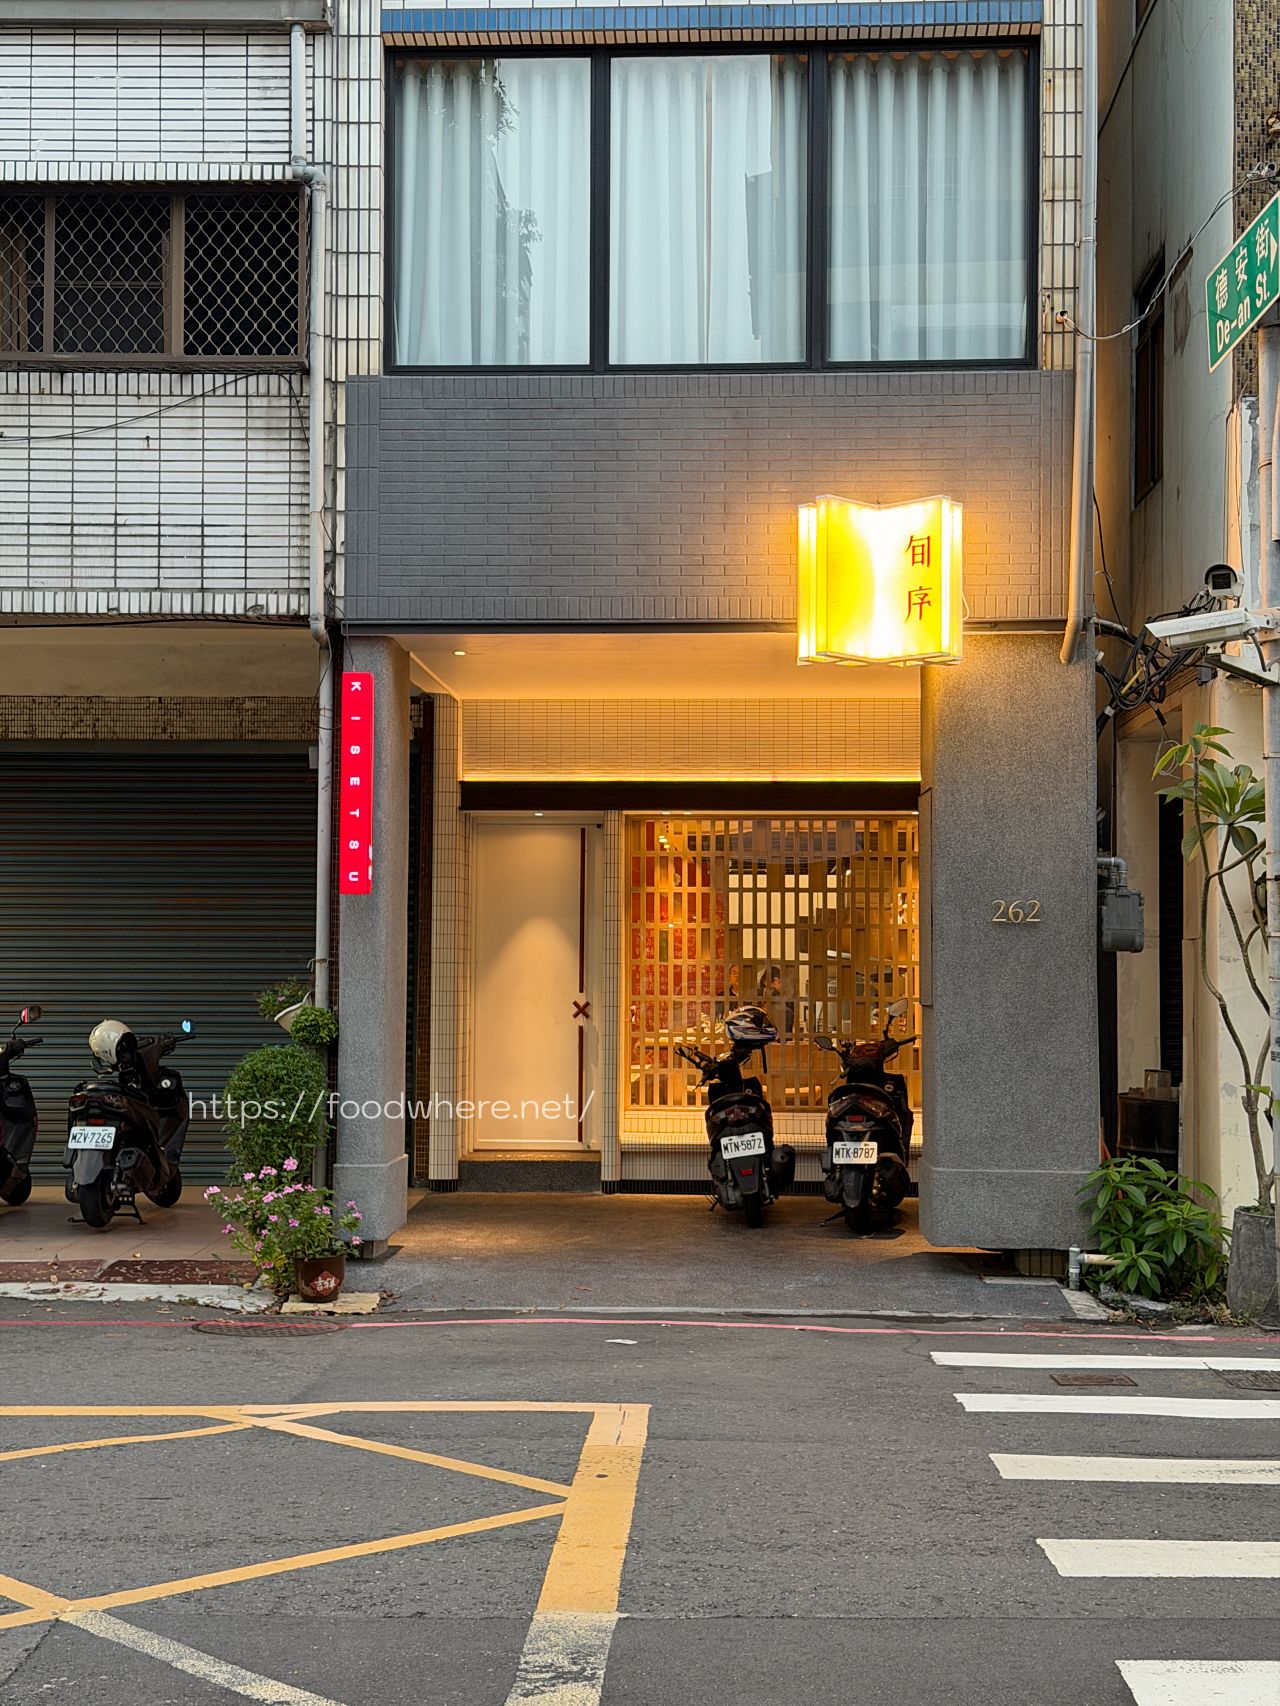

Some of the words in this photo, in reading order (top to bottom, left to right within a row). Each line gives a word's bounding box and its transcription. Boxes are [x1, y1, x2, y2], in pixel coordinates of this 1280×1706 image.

[1215, 218, 1269, 313] 德安街
[1216, 295, 1251, 353] De-an
[1255, 270, 1270, 308] St.
[904, 534, 933, 623] 旬序
[348, 681, 362, 882] KISETSU
[991, 899, 1041, 923] 262
[70, 1132, 113, 1144] MZV-7265
[722, 1137, 764, 1154] MTN-5872
[834, 1147, 875, 1159] MTK-8787
